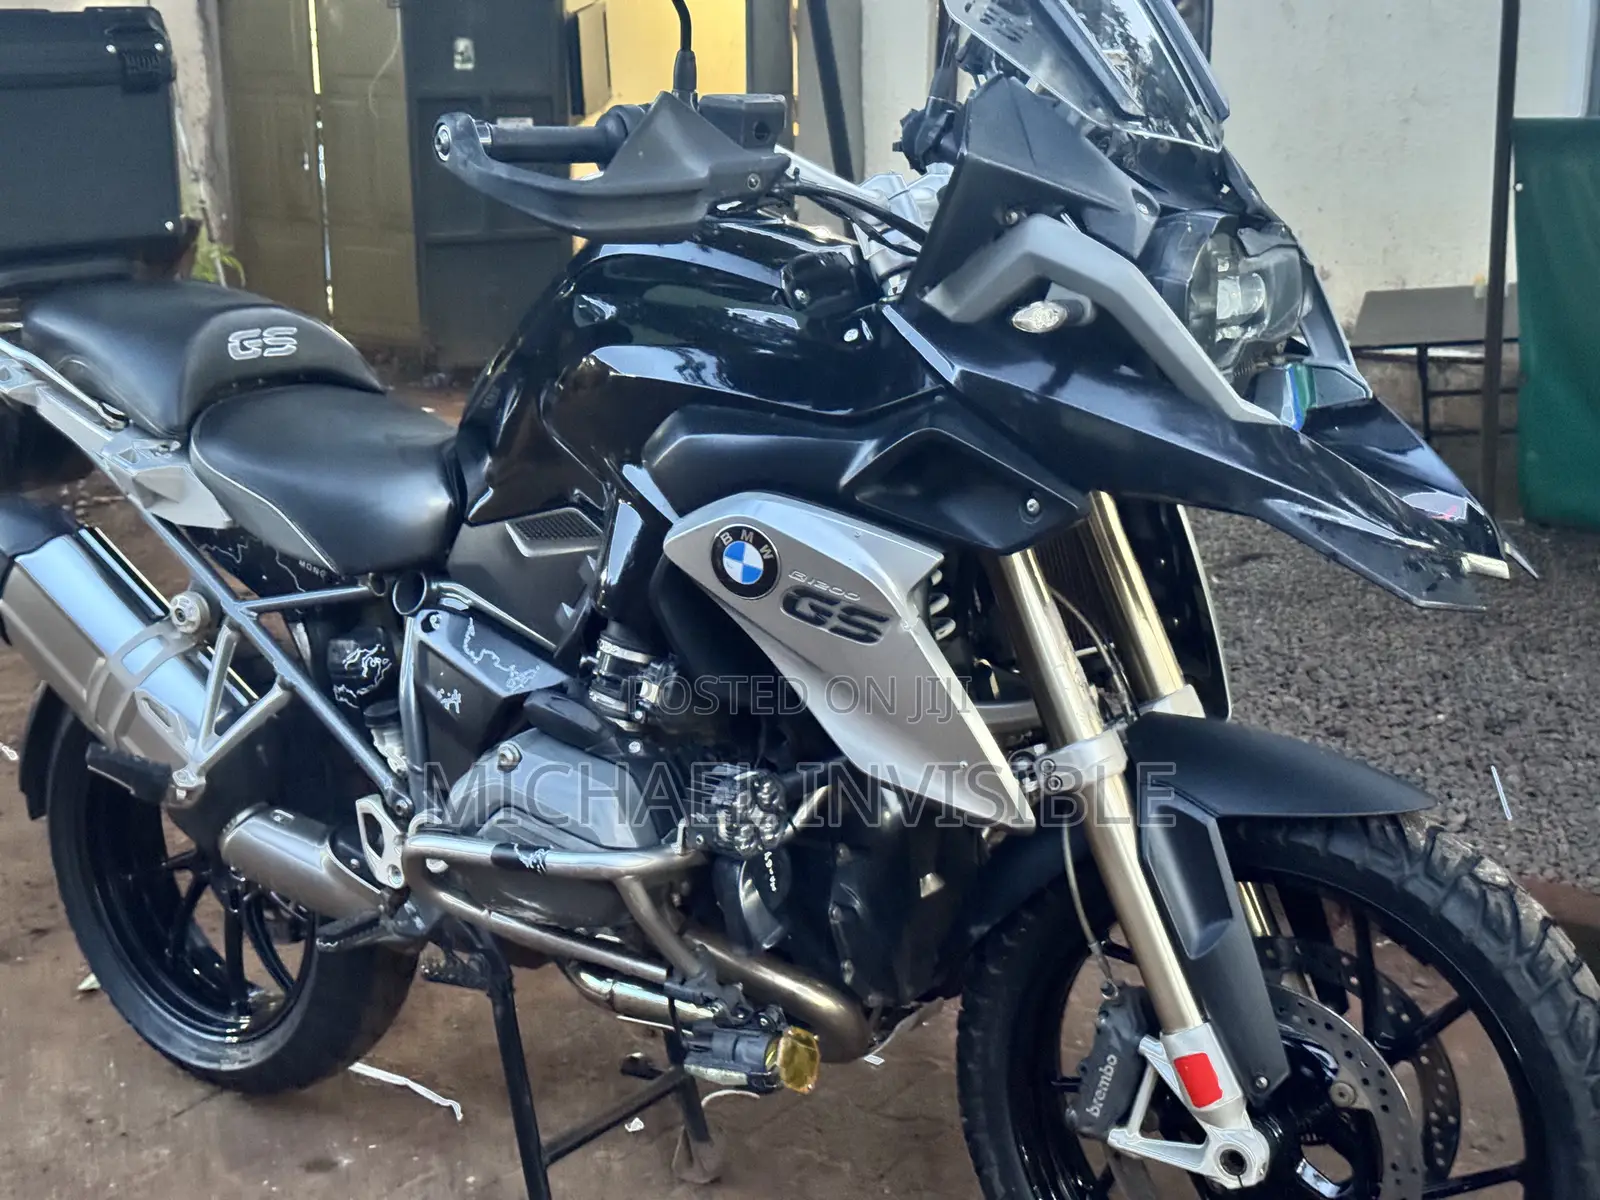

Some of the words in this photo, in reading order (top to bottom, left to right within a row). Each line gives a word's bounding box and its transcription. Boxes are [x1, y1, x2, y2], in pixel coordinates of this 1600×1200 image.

[228, 326, 297, 360] GS
[720, 529, 775, 560] BMW
[781, 585, 891, 644] GS
[1086, 1054, 1118, 1118] brembo
